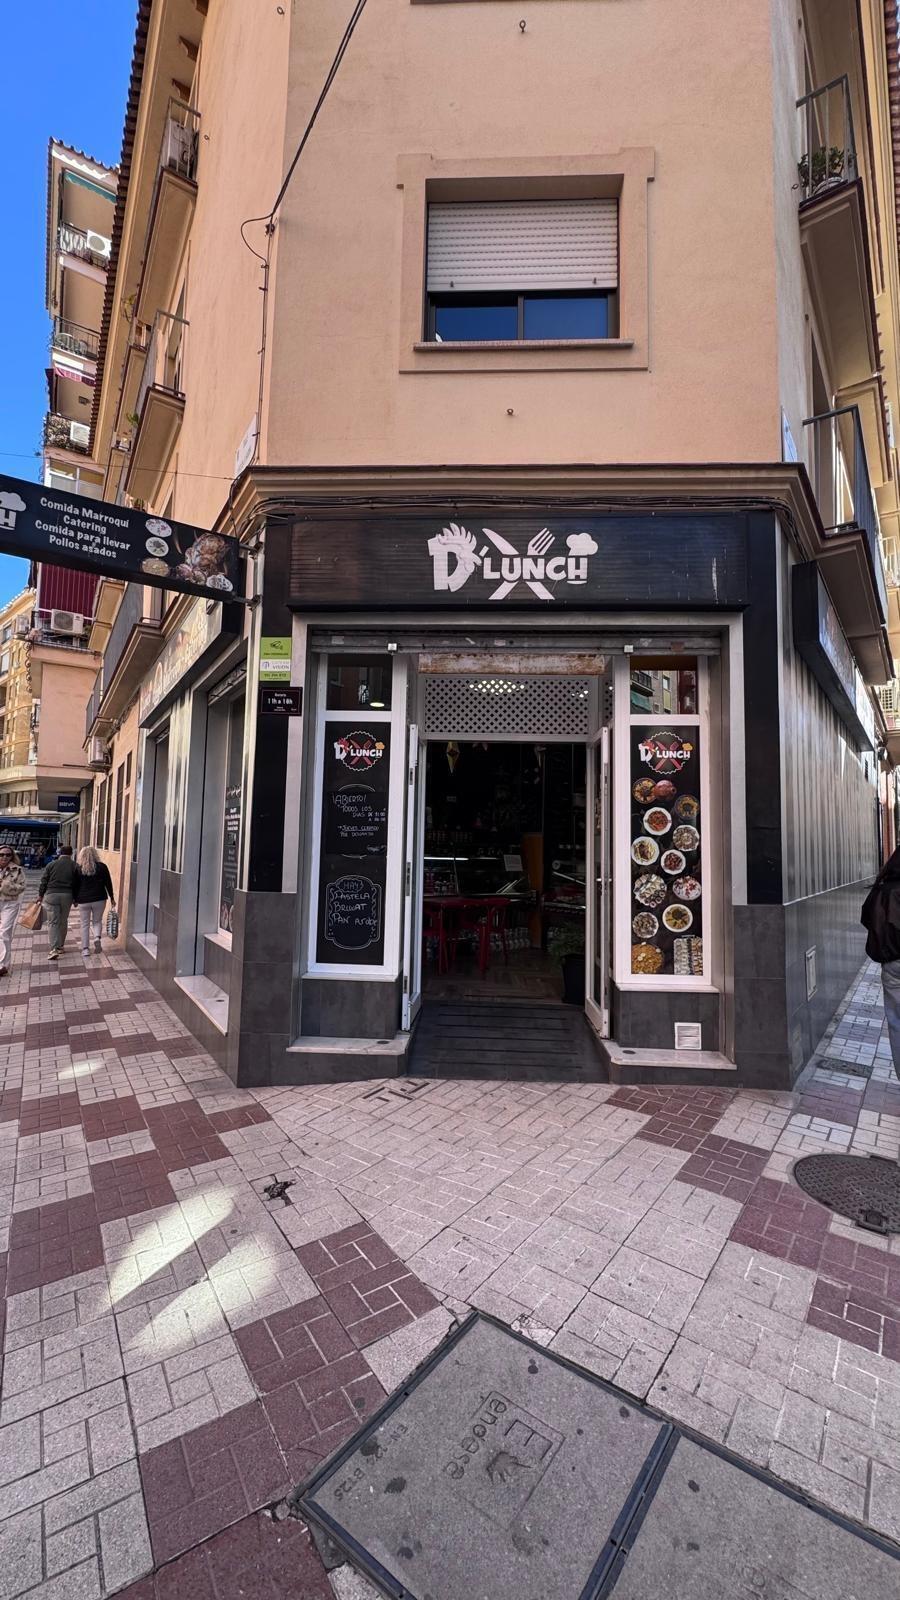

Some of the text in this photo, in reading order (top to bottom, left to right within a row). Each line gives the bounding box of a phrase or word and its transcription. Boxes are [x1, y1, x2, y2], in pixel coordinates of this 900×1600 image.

[40, 497, 80, 516] Comida
[63, 515, 107, 535] Catering
[35, 519, 76, 538] Comida
[77, 529, 102, 546] para
[103, 535, 131, 552] llevar
[49, 534, 117, 559] Pollos asados
[334, 889, 371, 901] PASTELA
[343, 881, 359, 890] HAY
